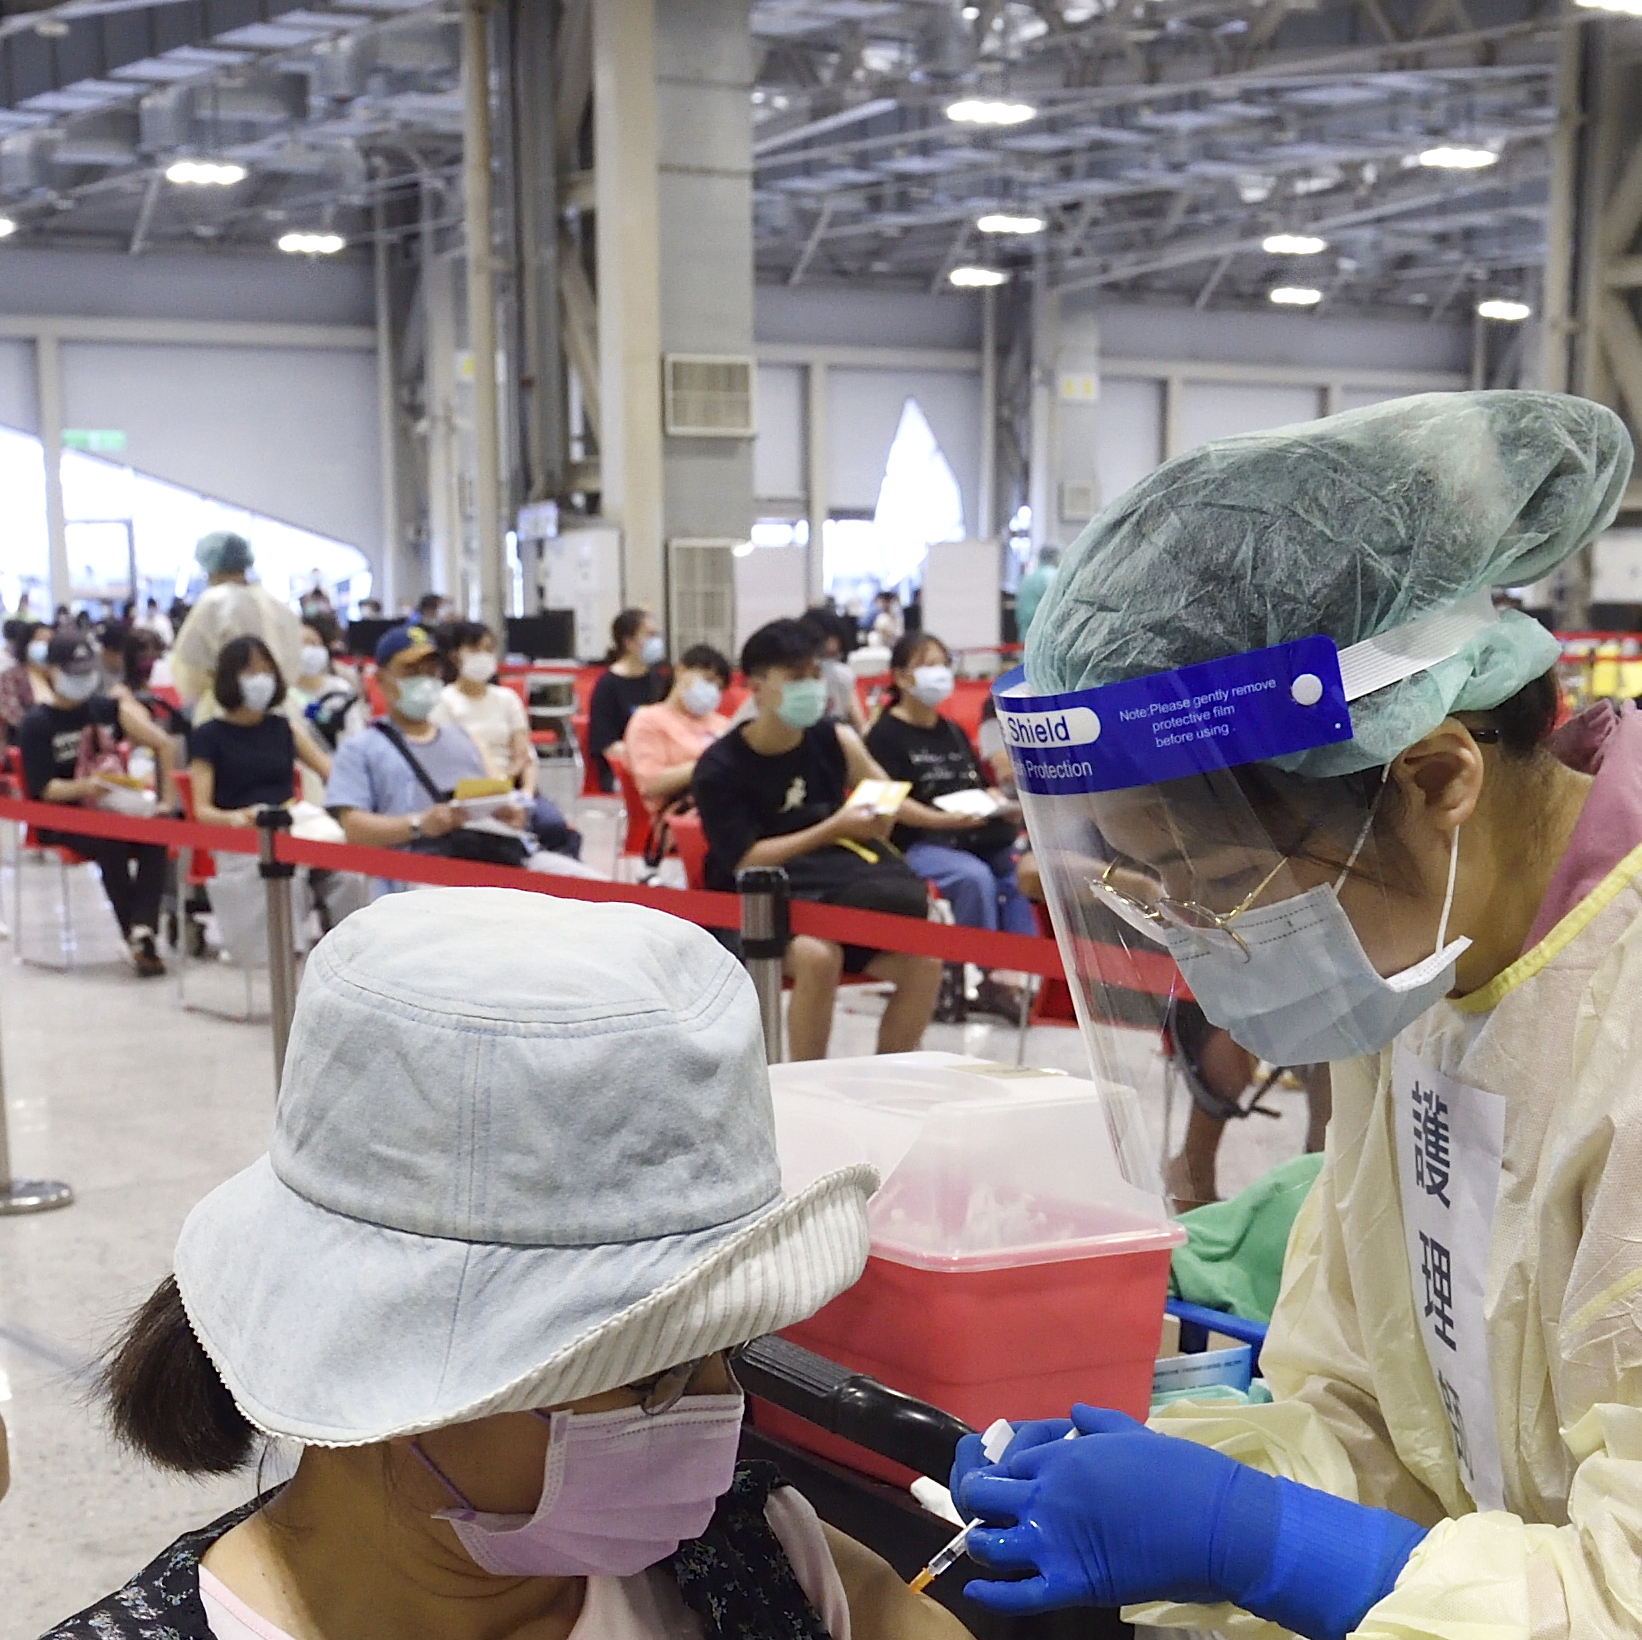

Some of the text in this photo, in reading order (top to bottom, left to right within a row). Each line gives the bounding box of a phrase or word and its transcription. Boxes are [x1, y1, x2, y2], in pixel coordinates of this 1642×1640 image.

[1193, 688, 1230, 709] gently
[1231, 677, 1277, 698] remove
[1007, 715, 1071, 744] Shield
[1152, 703, 1236, 735] protective film
[1155, 723, 1230, 749] before using
[1025, 760, 1093, 779] Protection
